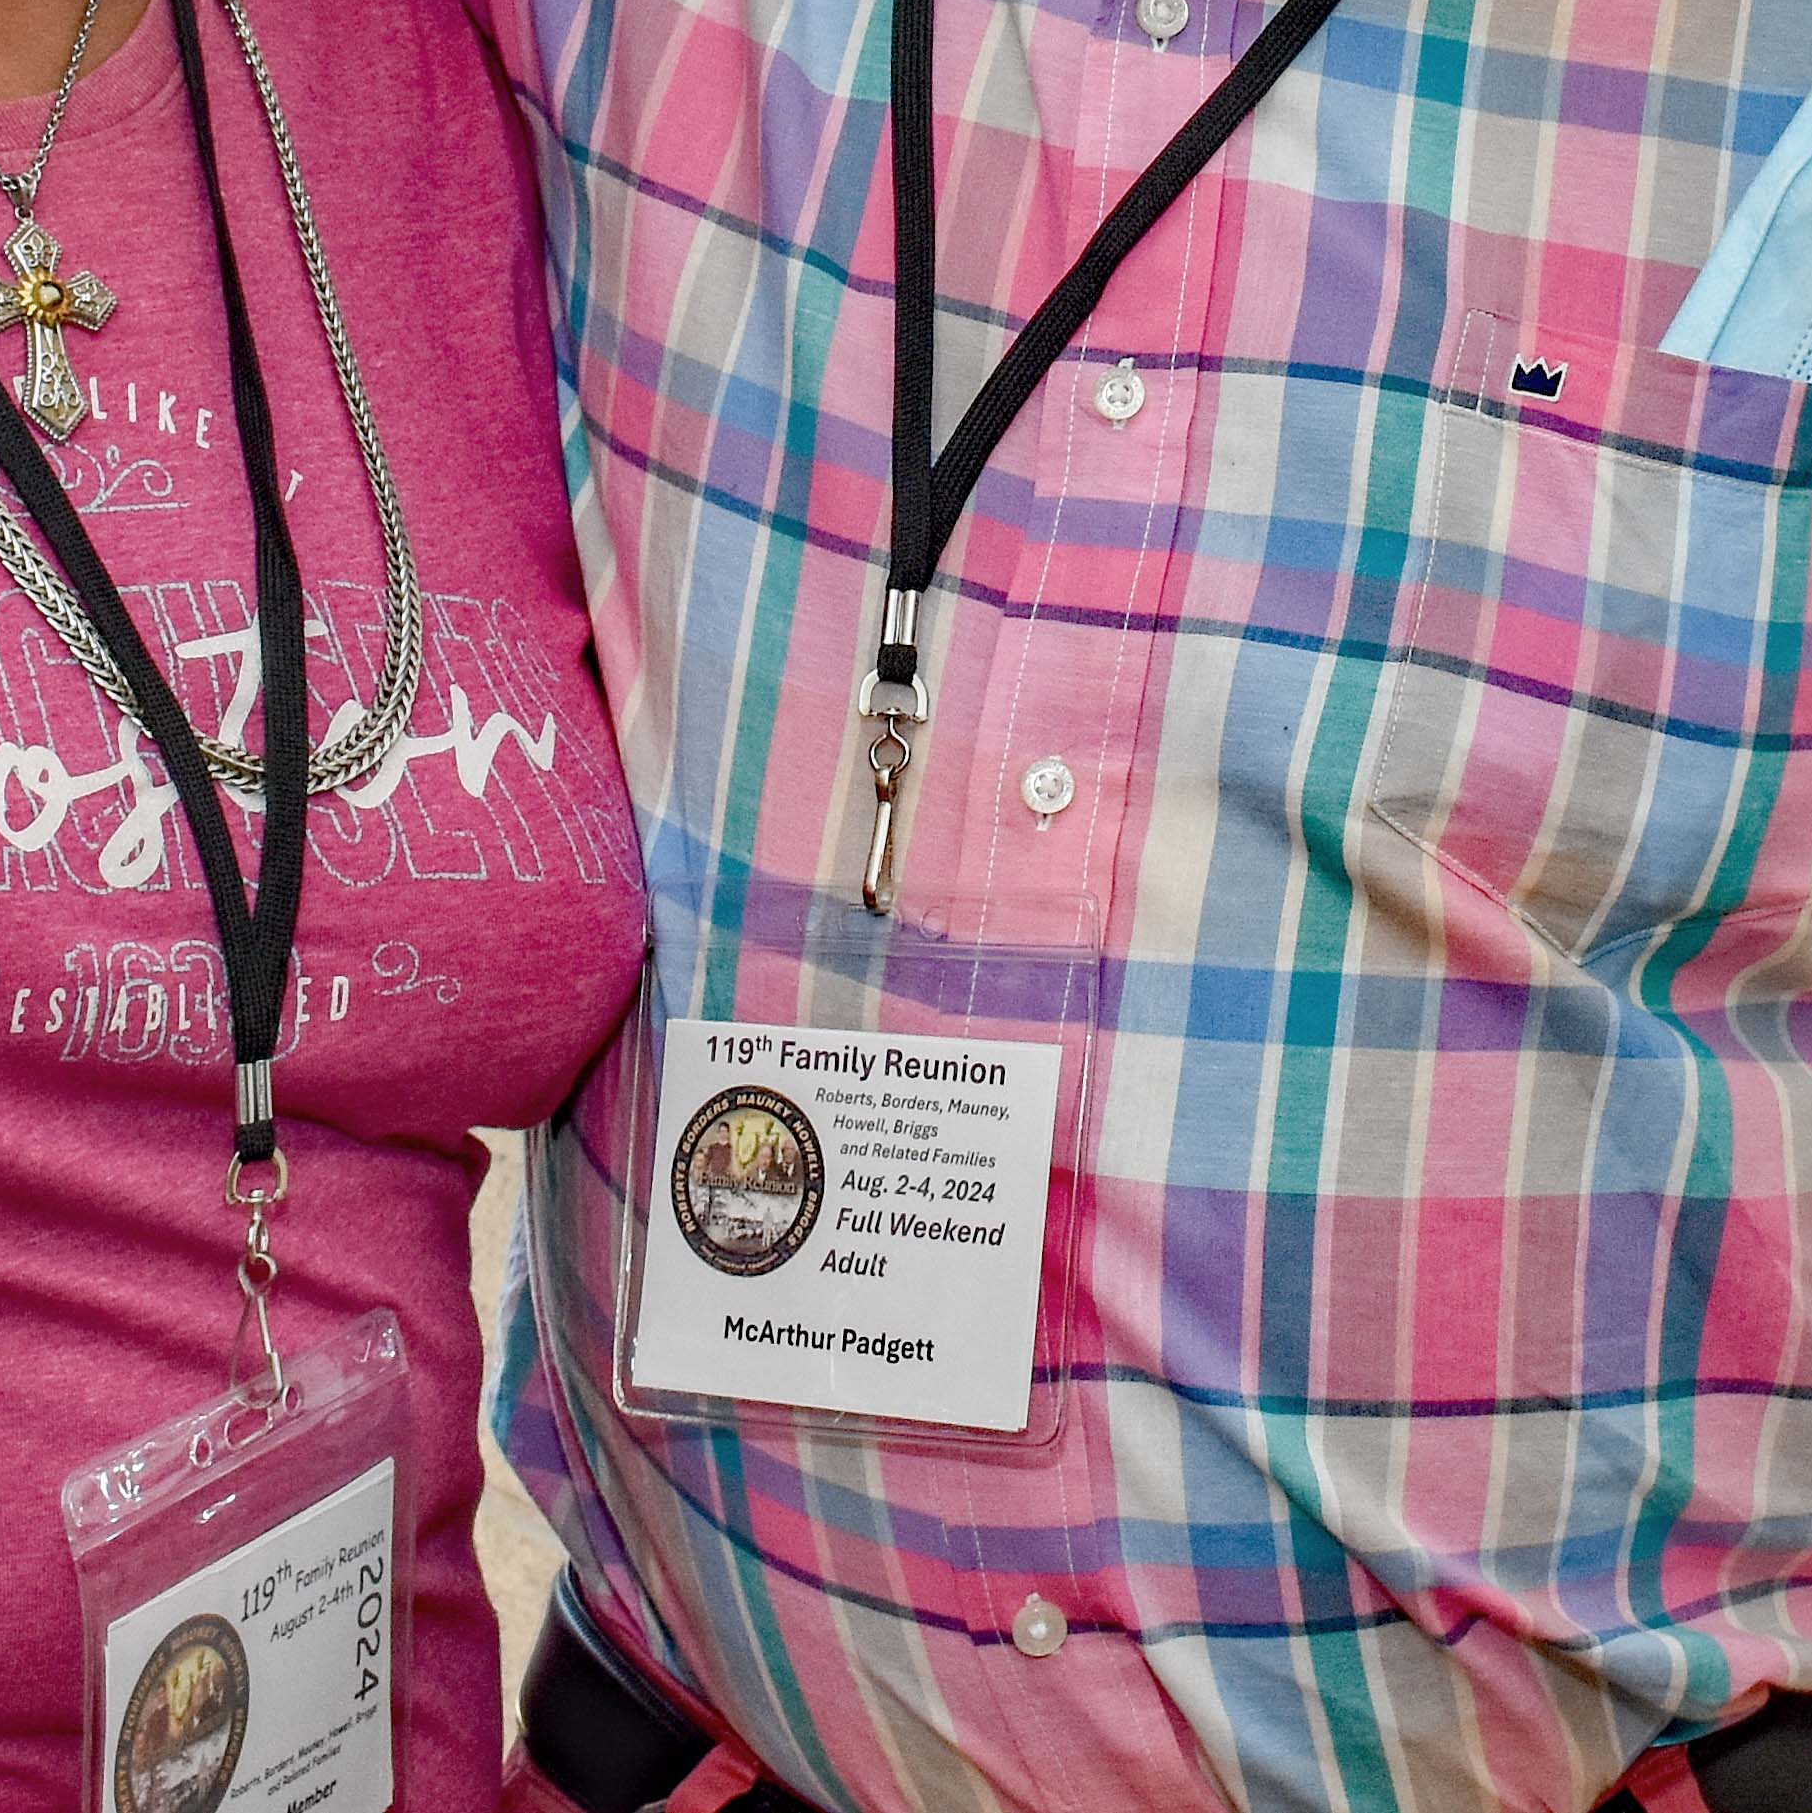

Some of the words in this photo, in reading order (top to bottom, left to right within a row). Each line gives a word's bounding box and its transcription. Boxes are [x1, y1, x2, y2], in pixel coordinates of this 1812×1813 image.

[89, 376, 214, 450] LIKE
[10, 975, 350, 1035] ESTABLIED
[706, 1035, 772, 1064] 119th
[780, 1041, 876, 1081] Family
[884, 1049, 1006, 1085] Reunion
[682, 1097, 730, 1153] BORDERS
[736, 1093, 792, 1118] MAUNEY
[815, 1087, 877, 1109] Roberts,
[881, 1093, 943, 1114] Borders,
[948, 1099, 1011, 1120] Mauney,
[833, 1115, 889, 1134] Howell,
[893, 1120, 939, 1139] Briggs
[792, 1119, 820, 1181] HOWELL
[840, 1143, 867, 1157] and
[872, 1144, 928, 1163] Related
[932, 1149, 997, 1169] Families
[676, 1161, 697, 1232] ROBERTS
[841, 1170, 888, 1198] Aug.
[894, 1175, 936, 1201] 2-4,
[942, 1179, 996, 1203] 2024
[788, 1190, 818, 1246] BRIGGS
[836, 1207, 882, 1234] Full
[890, 1212, 1006, 1246] Weekend
[820, 1249, 888, 1277] Adult
[724, 1315, 836, 1351] McArthur
[842, 1328, 935, 1364] Padgett
[241, 1559, 292, 1623] 119th
[295, 1556, 336, 1592] Family
[339, 1529, 385, 1566] Reunion
[270, 1604, 315, 1643] August
[318, 1580, 354, 1615] 2-4th
[354, 1555, 384, 1702] 2024
[287, 1780, 337, 1813] Member
